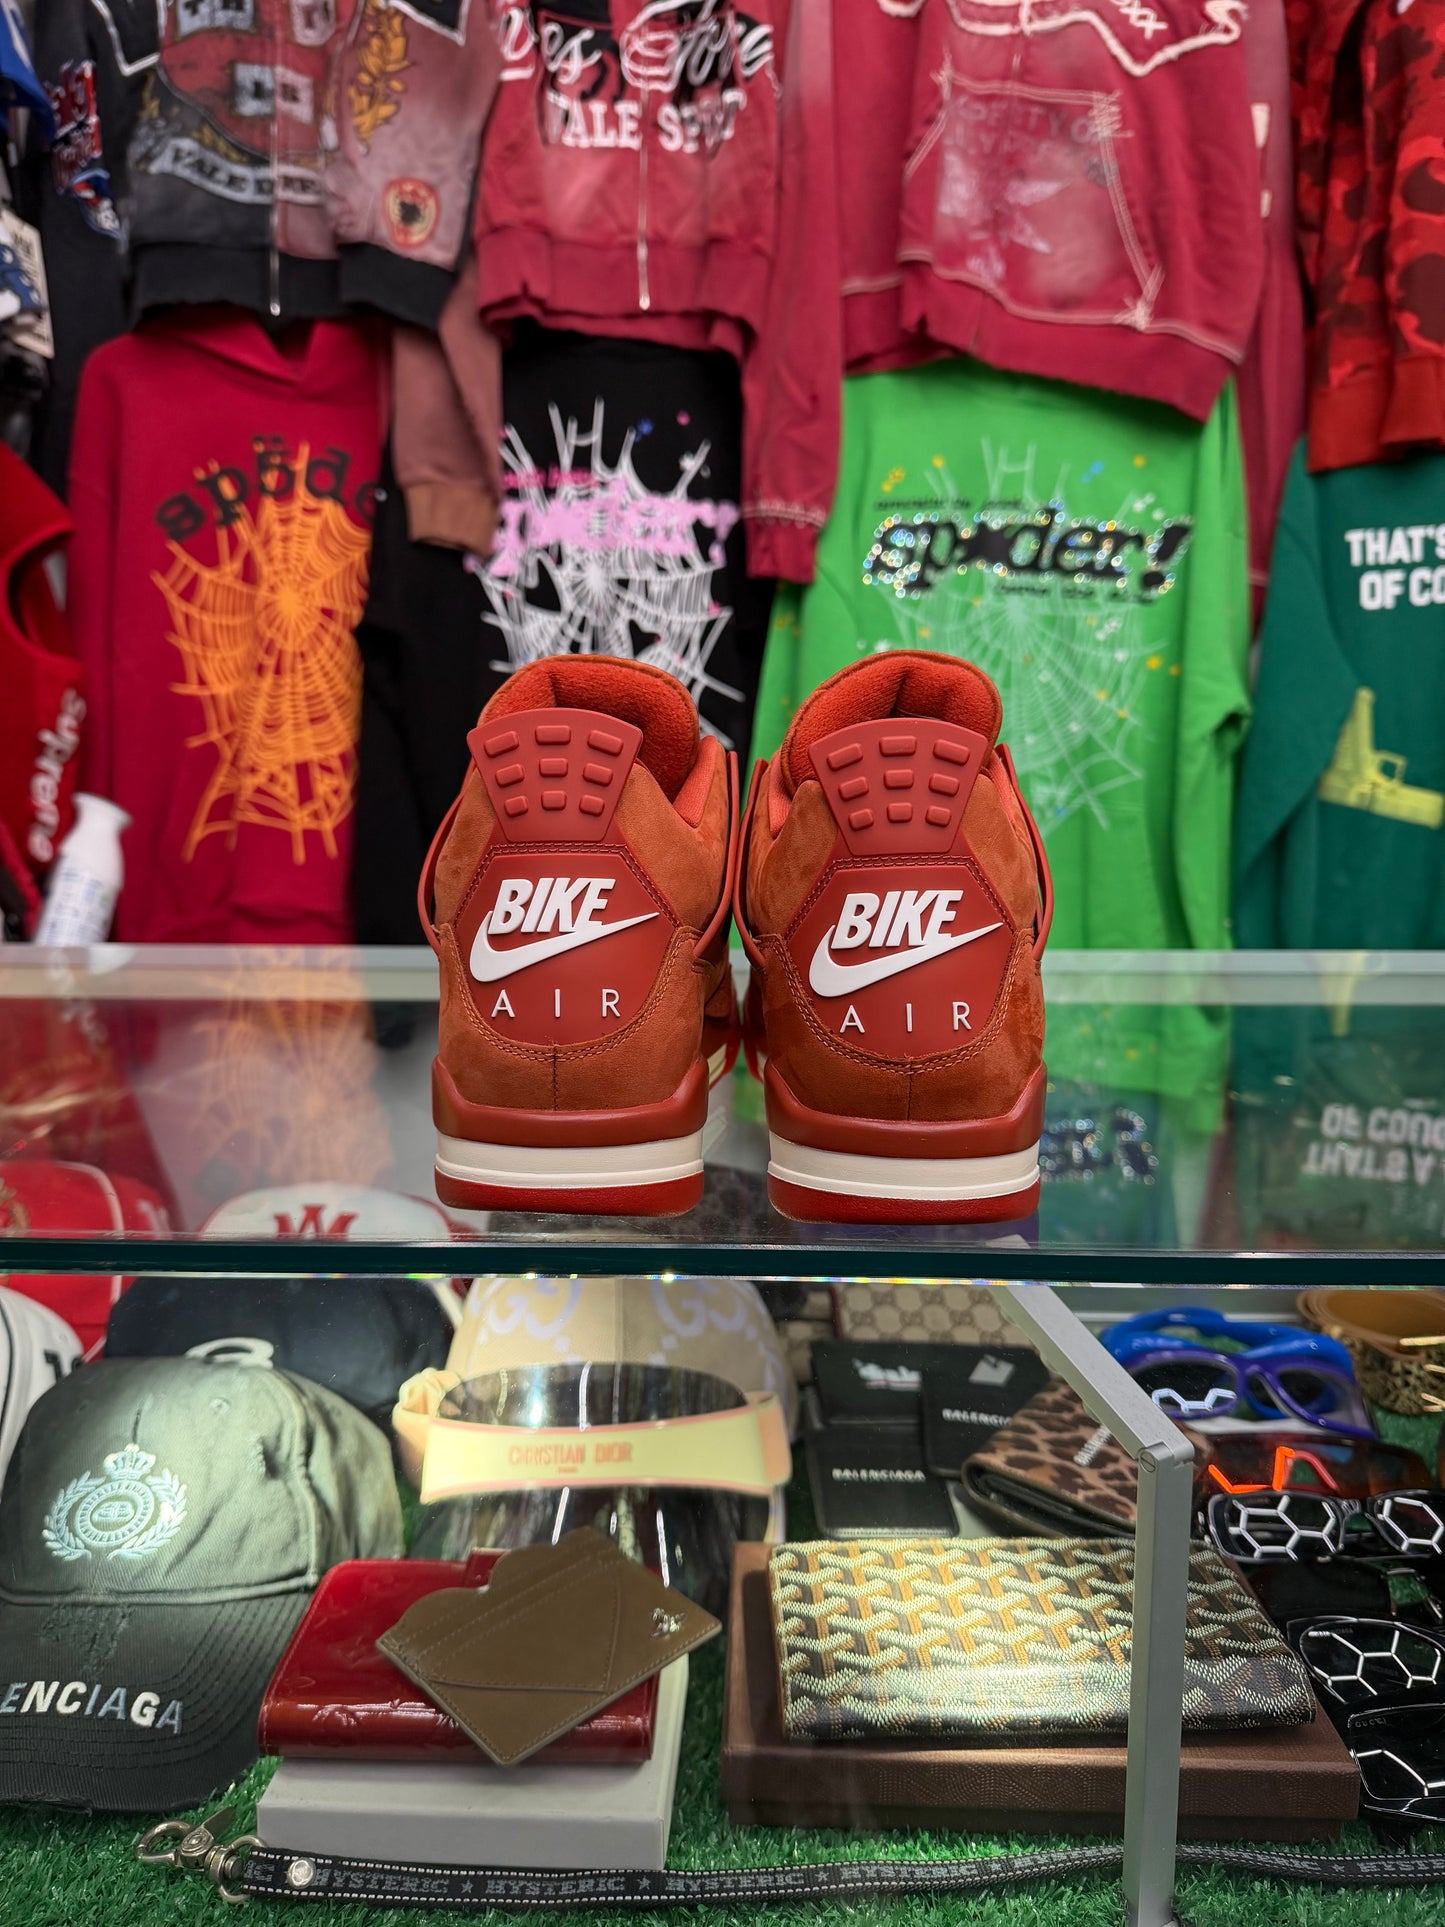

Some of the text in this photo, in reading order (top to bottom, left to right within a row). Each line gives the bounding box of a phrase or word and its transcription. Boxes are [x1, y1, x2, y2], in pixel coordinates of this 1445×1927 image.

[1358, 569, 1407, 611] OF
[487, 877, 616, 935] BIKE
[830, 889, 963, 949] BIKE
[490, 988, 621, 1018] AIR
[839, 1001, 972, 1034] AIR
[508, 1441, 633, 1467] CHRISTIAN DIOR
[831, 1467, 927, 1484] BALENCIAGA
[0, 1680, 184, 1735] ENCIAGA
[313, 1868, 450, 1894] HYSTERIC
[486, 1876, 626, 1896] HYSTERIC
[665, 1872, 805, 1892] HYSTERIC
[840, 1862, 977, 1882] HYSTERIC
